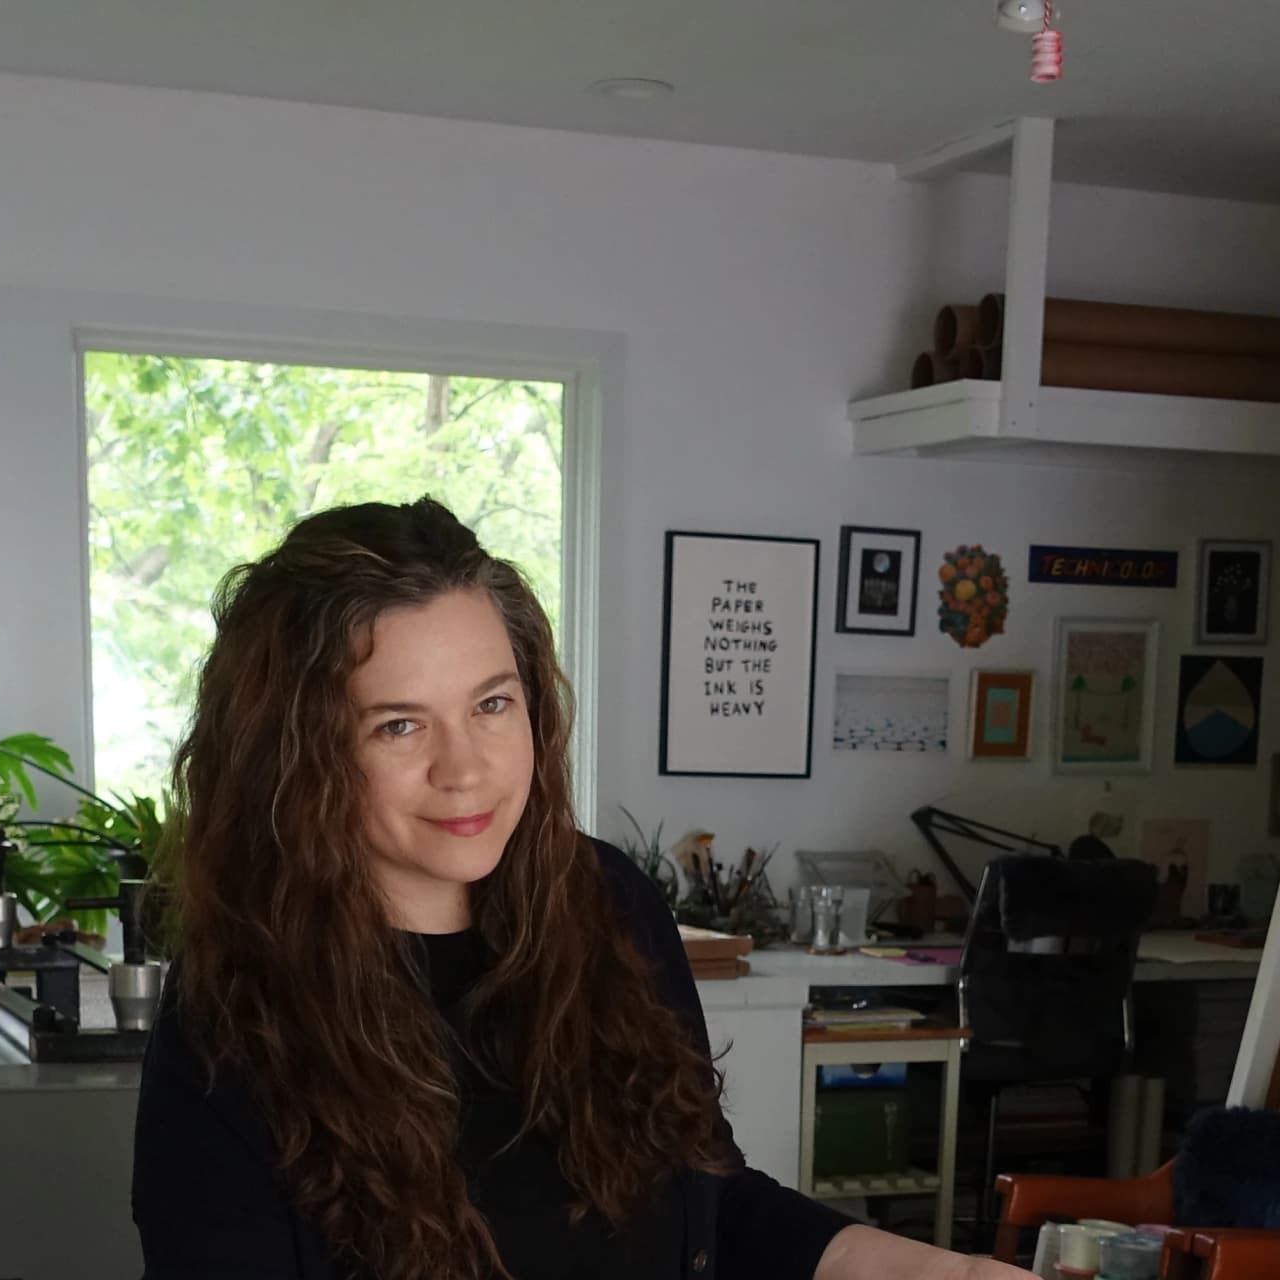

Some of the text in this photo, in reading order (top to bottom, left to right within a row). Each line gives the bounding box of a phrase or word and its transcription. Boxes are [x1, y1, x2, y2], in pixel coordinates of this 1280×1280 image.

[723, 580, 757, 594] THE
[711, 597, 764, 614] PAPER
[709, 619, 773, 636] WEIGHS
[704, 636, 778, 652] NOTHING
[705, 657, 772, 674] BUT THE
[704, 679, 764, 696] INK IS
[710, 701, 765, 717] HEAVY
